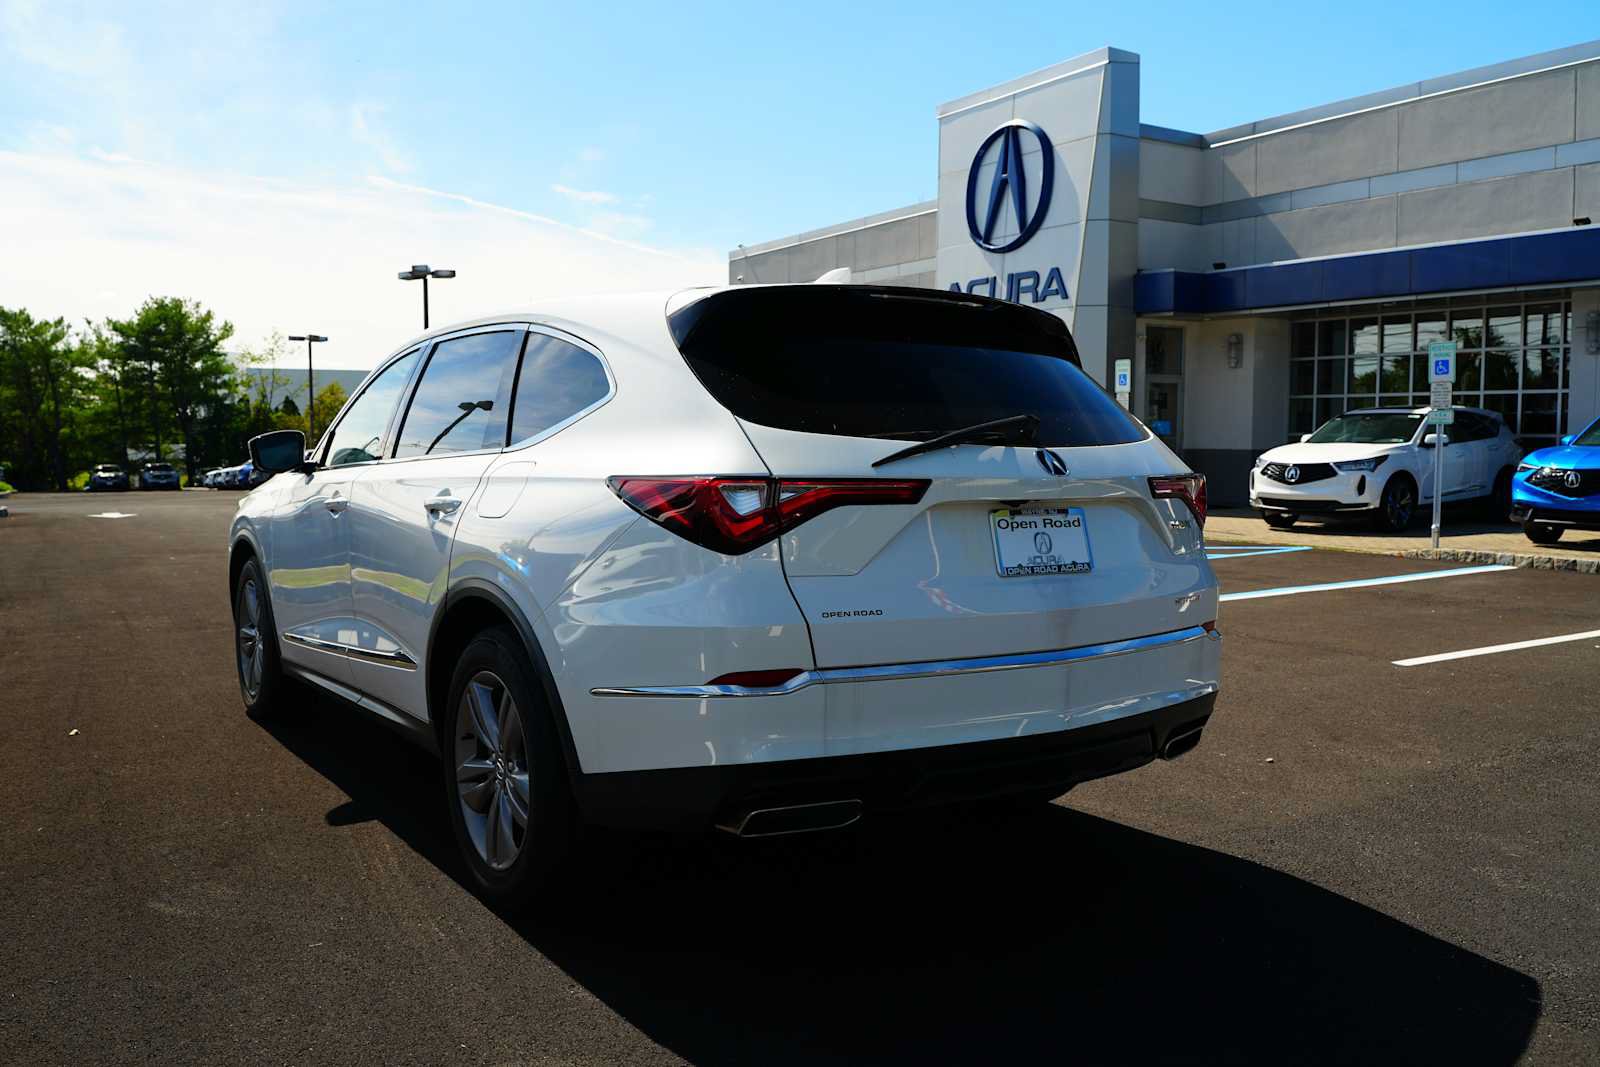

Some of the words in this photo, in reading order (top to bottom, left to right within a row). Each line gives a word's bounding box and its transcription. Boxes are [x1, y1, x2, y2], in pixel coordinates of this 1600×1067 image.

[997, 518, 1038, 532] Open
[1042, 517, 1081, 528] Road
[1007, 566, 1032, 576] OPEN
[1033, 565, 1059, 574] ROAD
[1060, 562, 1090, 573] ACURA
[853, 609, 883, 617] ROAD
